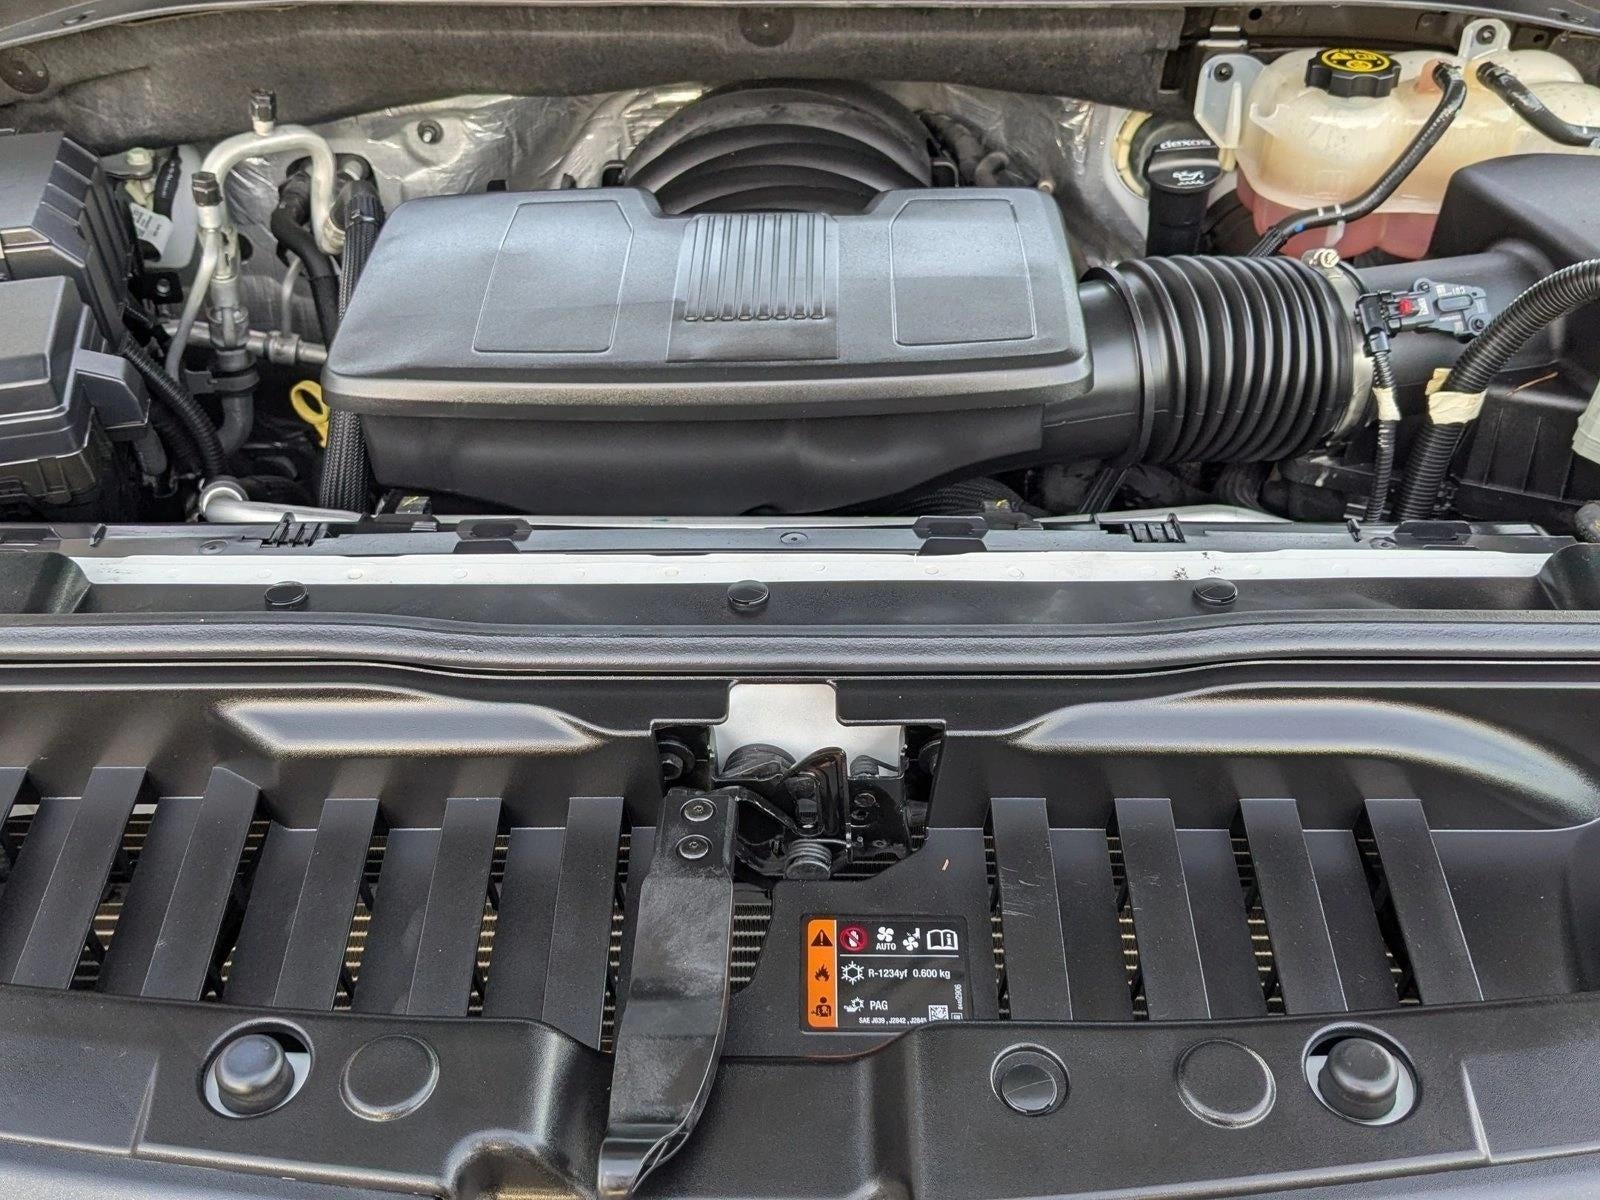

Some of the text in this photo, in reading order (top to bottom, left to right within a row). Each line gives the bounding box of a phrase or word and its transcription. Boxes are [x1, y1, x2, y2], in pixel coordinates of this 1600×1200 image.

[1160, 139, 1210, 149] dexos
[868, 969, 951, 979] R-1234yf 0.600 kg
[869, 1000, 889, 1010] PAG
